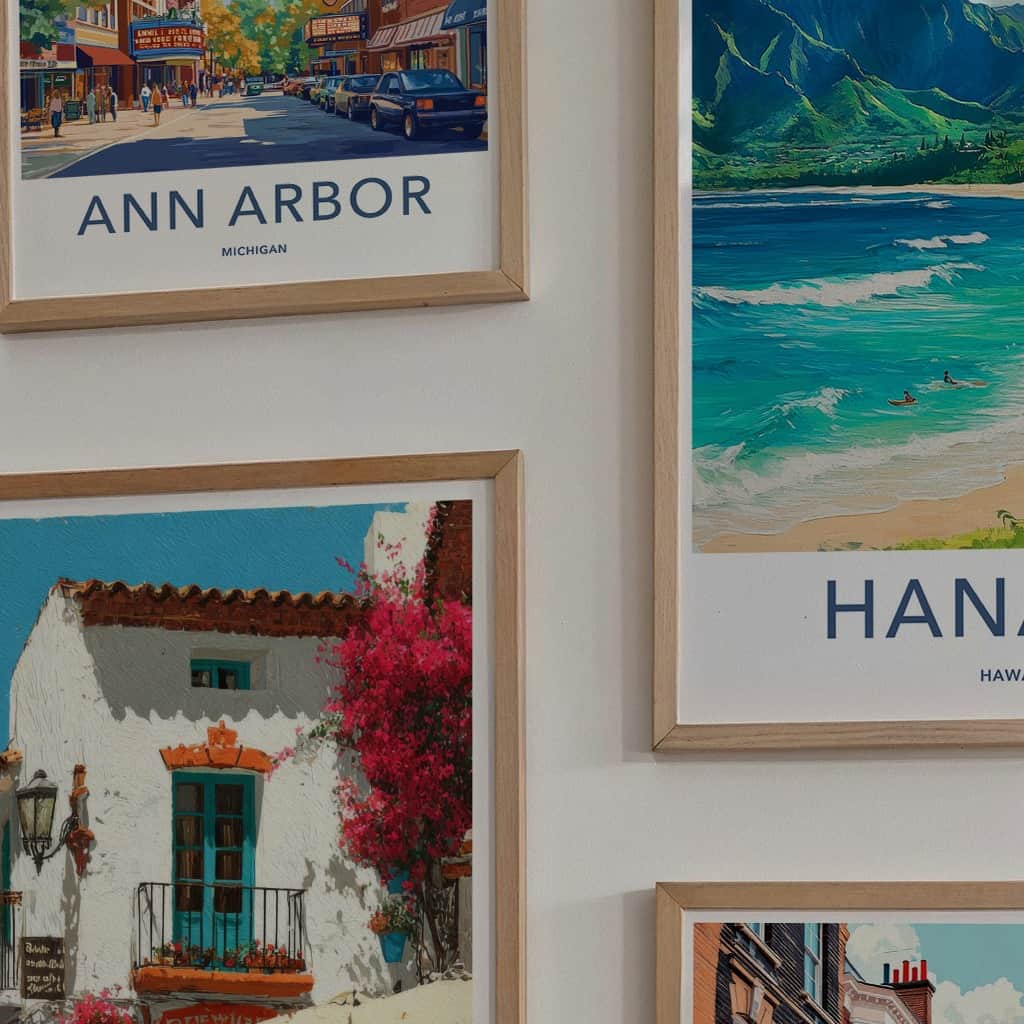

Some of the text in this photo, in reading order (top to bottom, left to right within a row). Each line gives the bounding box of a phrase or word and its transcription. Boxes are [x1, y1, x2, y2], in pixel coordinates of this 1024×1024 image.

[77, 175, 432, 236] ANN ARBOR
[221, 244, 288, 257] MICHIGAN
[826, 577, 1024, 639] HAN
[980, 667, 1024, 682] HAW
